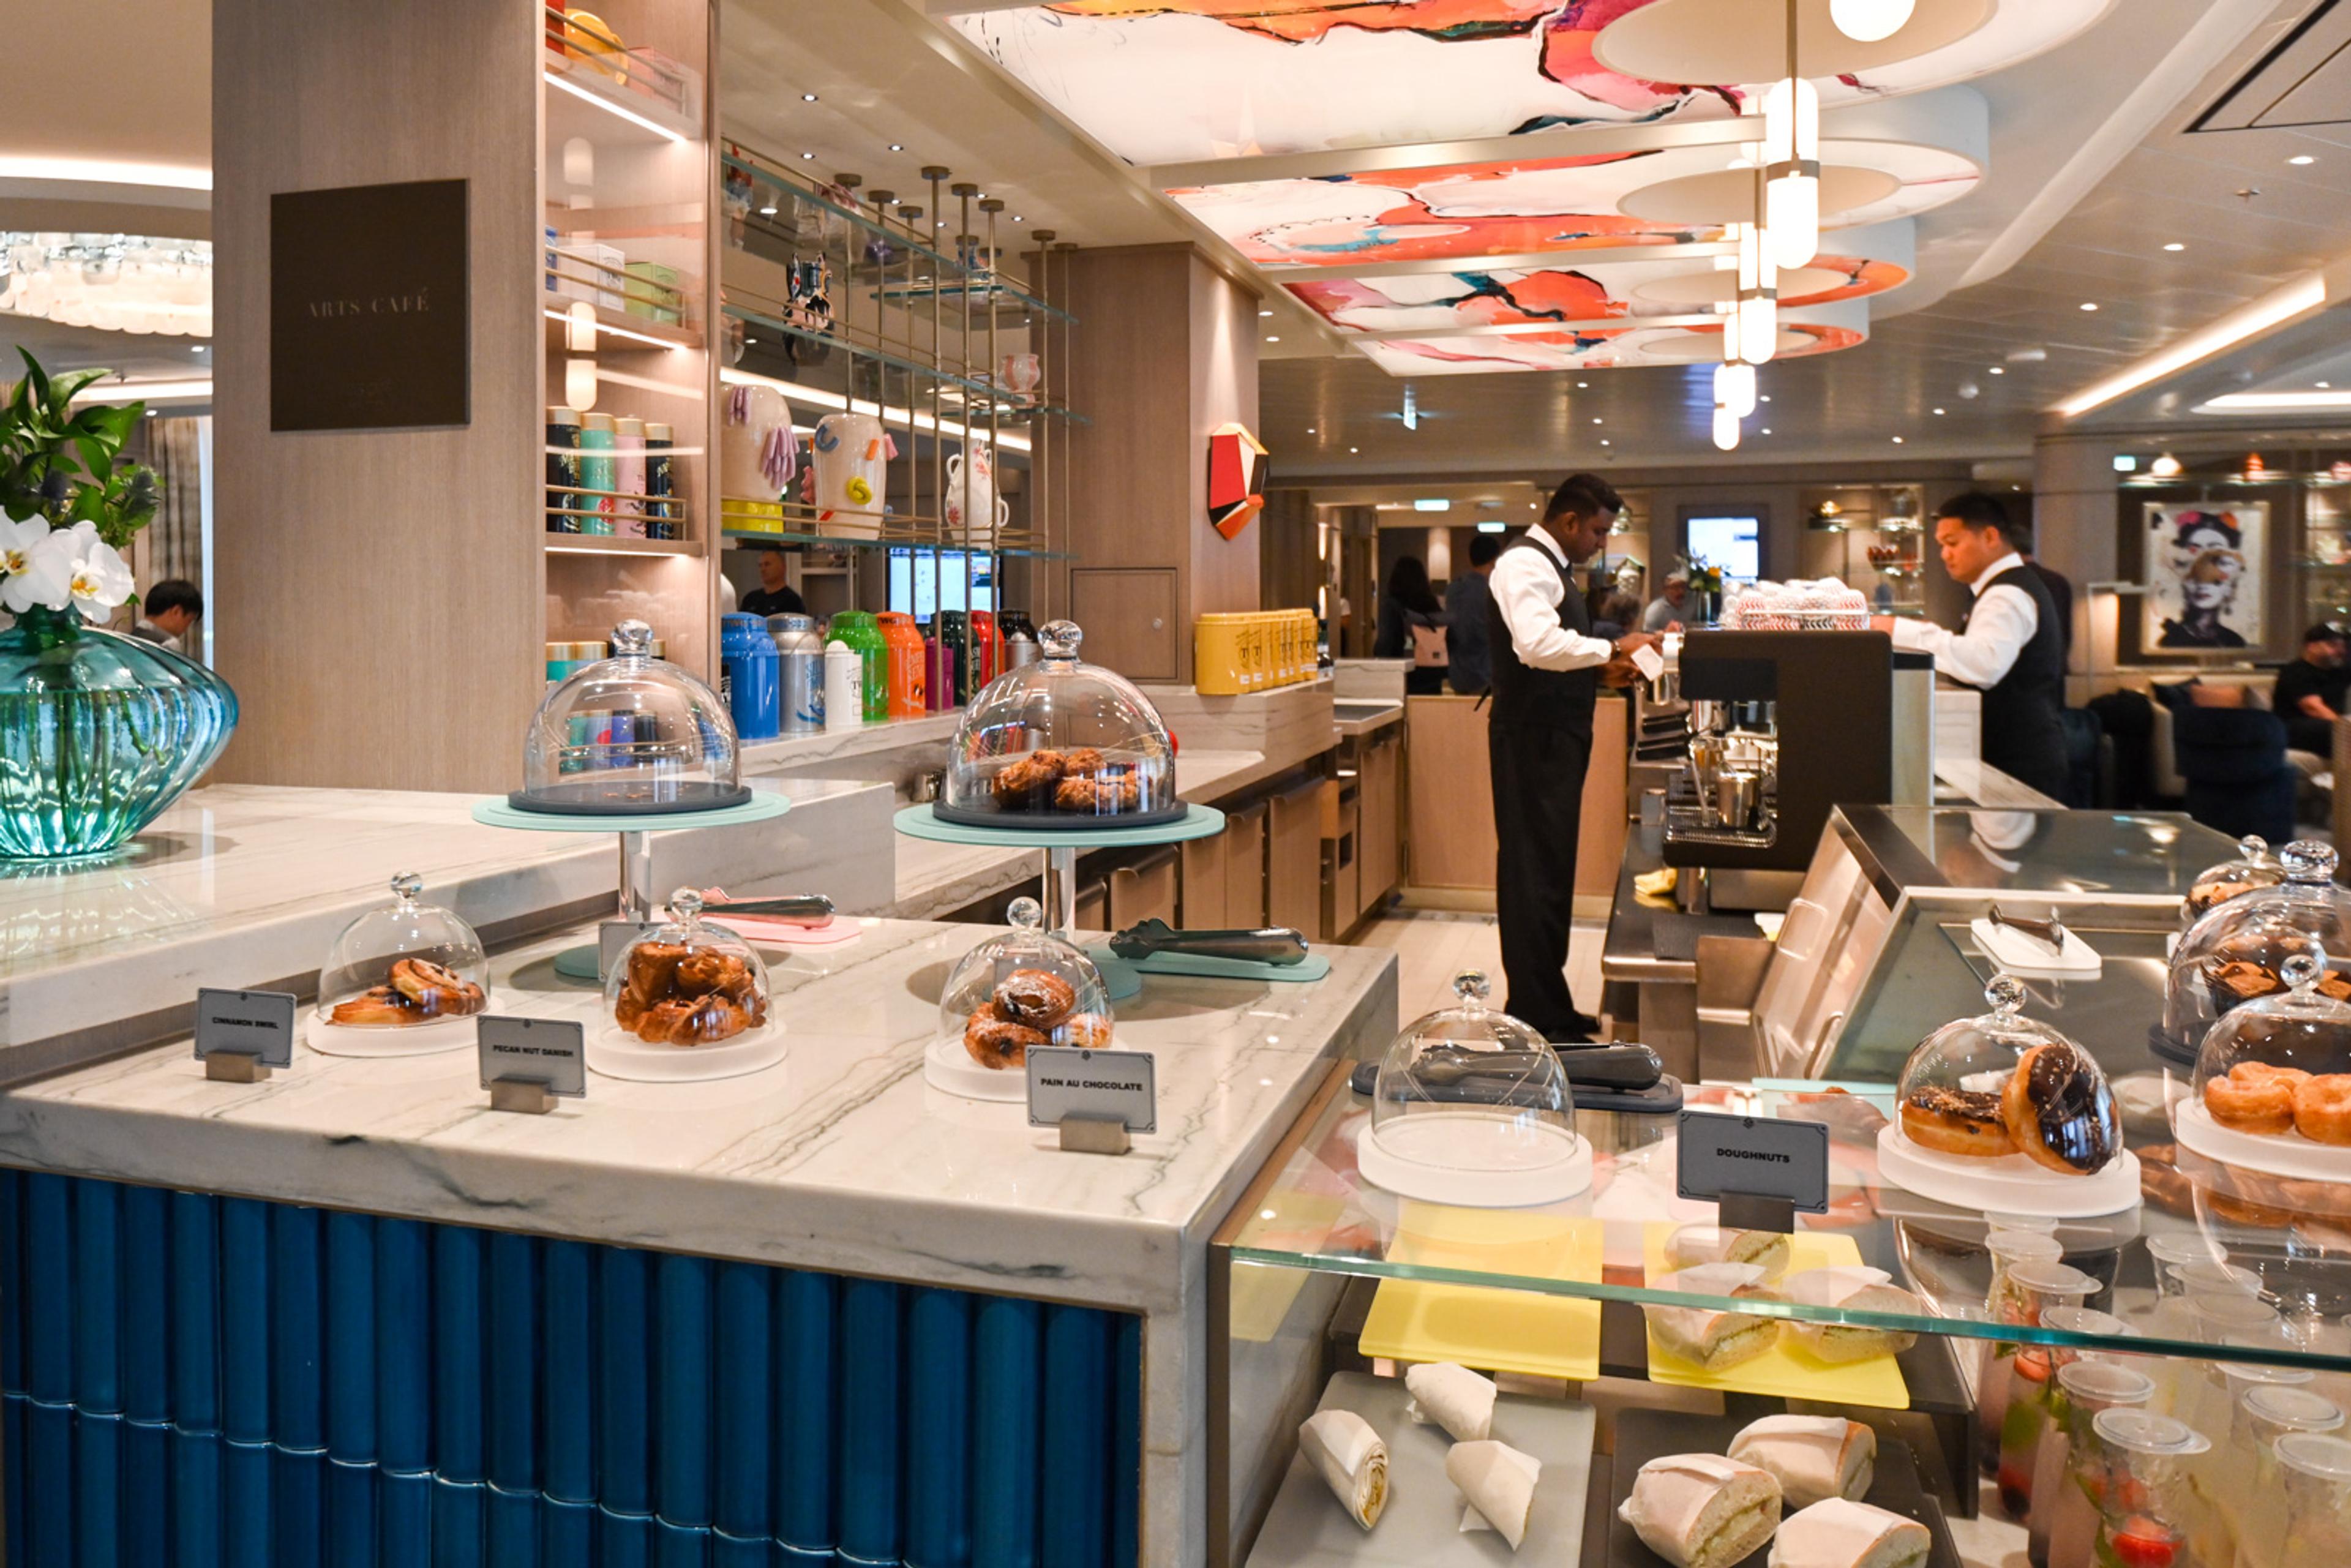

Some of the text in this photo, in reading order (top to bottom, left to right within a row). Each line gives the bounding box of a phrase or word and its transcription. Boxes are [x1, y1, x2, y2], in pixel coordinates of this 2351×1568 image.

[309, 287, 430, 318] ARTS CAFÉ
[211, 1016, 253, 1026] CINNAMON
[493, 1045, 520, 1054] PECAN
[1040, 1078, 1063, 1087] PAIN
[1082, 1080, 1143, 1091] CHOCOLATE
[1716, 1147, 1791, 1163] DOUGHNUTS
